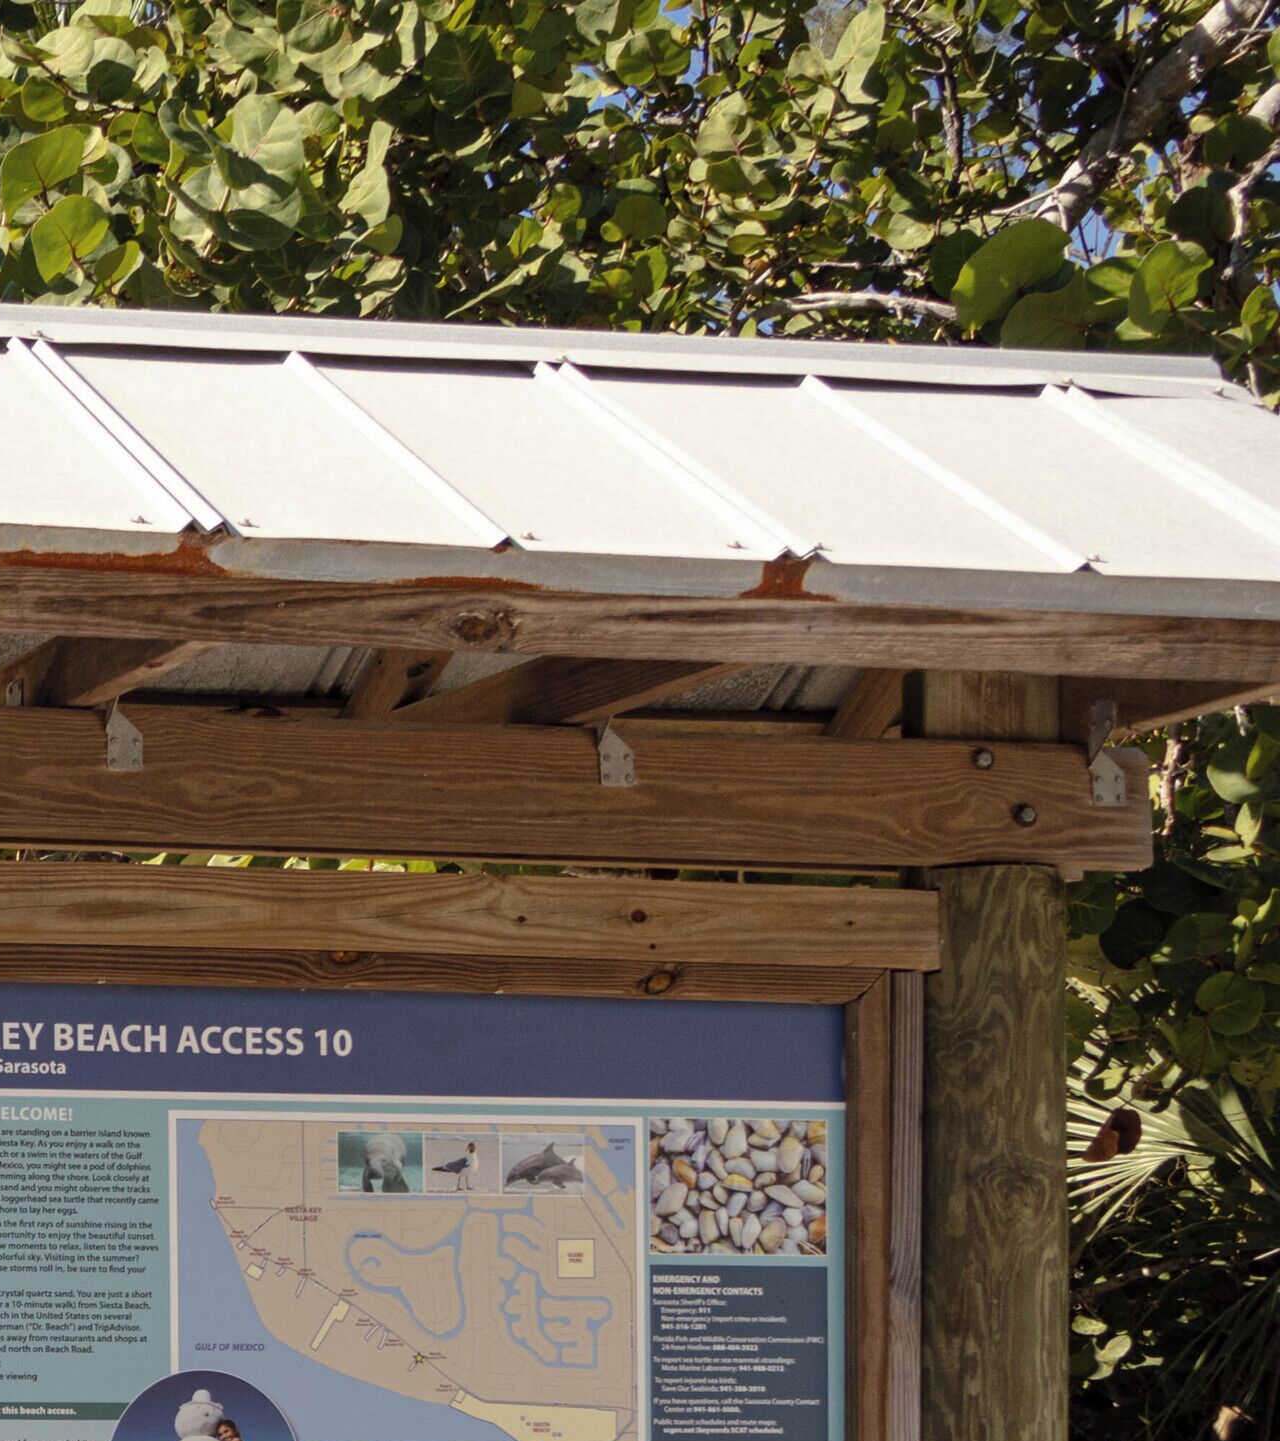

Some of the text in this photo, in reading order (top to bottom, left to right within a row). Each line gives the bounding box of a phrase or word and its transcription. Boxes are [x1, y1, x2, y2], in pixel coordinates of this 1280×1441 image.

[53, 1023, 167, 1056] BEACH
[177, 1026, 303, 1058] ACCESS
[315, 1028, 352, 1059] 10
[15, 1129, 50, 1139] standing
[69, 1129, 96, 1138] barrier
[98, 1130, 122, 1138] island
[122, 1130, 150, 1138] known
[285, 1207, 321, 1215] SIESTA KEY
[652, 1275, 719, 1284] EMERGENCY AND
[652, 1287, 762, 1296] NON-EMERGENCY CONTACTS
[194, 1342, 265, 1353] GULF OF MEXICO
[5, 1373, 37, 1383] viewing
[1, 1406, 18, 1415] this
[19, 1406, 45, 1415] beach
